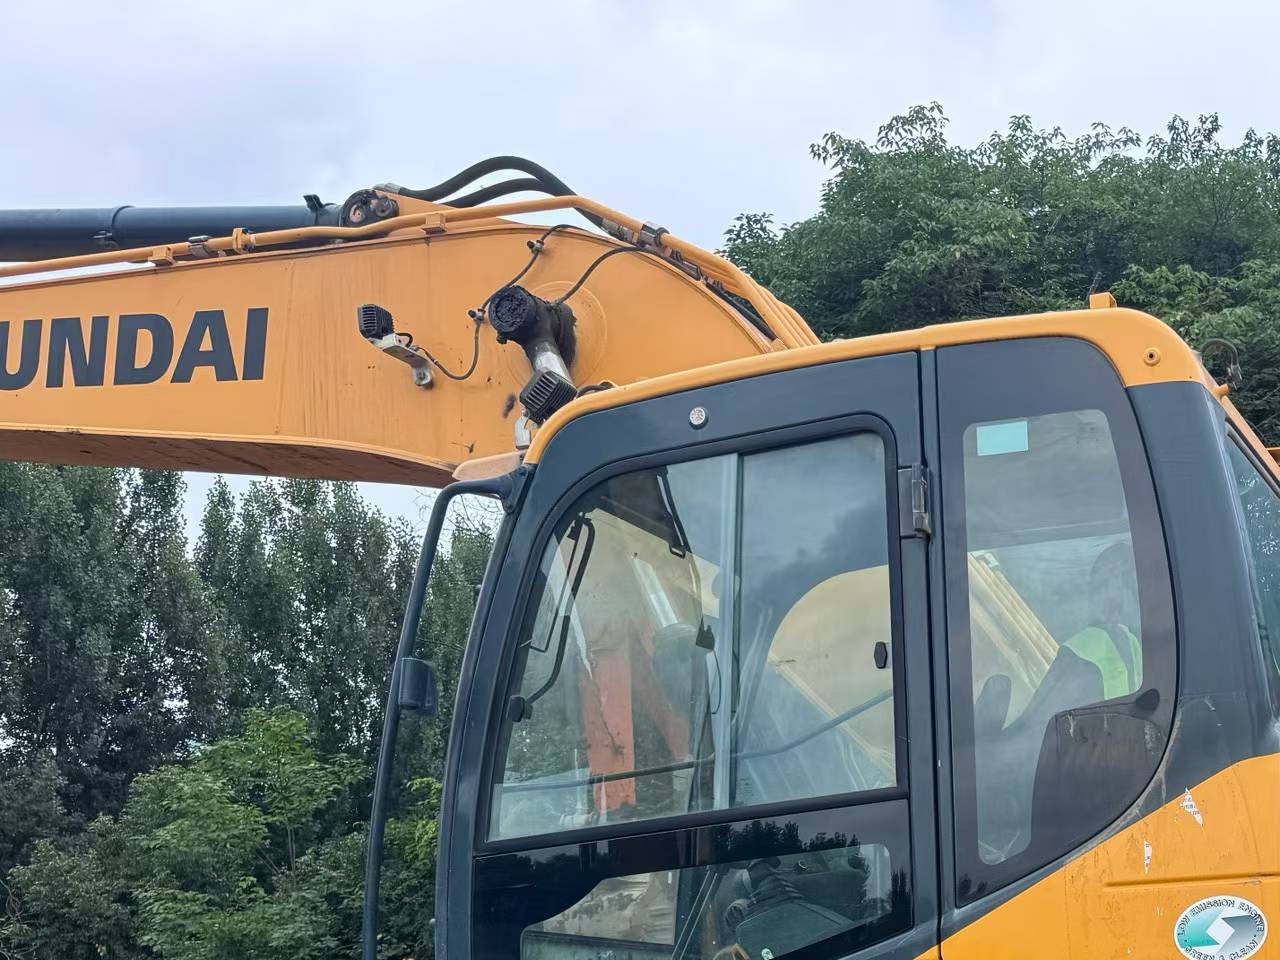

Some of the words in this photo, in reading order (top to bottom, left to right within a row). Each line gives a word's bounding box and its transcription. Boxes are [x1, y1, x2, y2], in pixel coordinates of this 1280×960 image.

[0, 307, 269, 391] UNDAI
[1177, 915, 1191, 936] LOW
[1190, 898, 1236, 917] EMISSION
[1238, 902, 1265, 932] ENGINE
[1229, 939, 1258, 960] CLEAN
